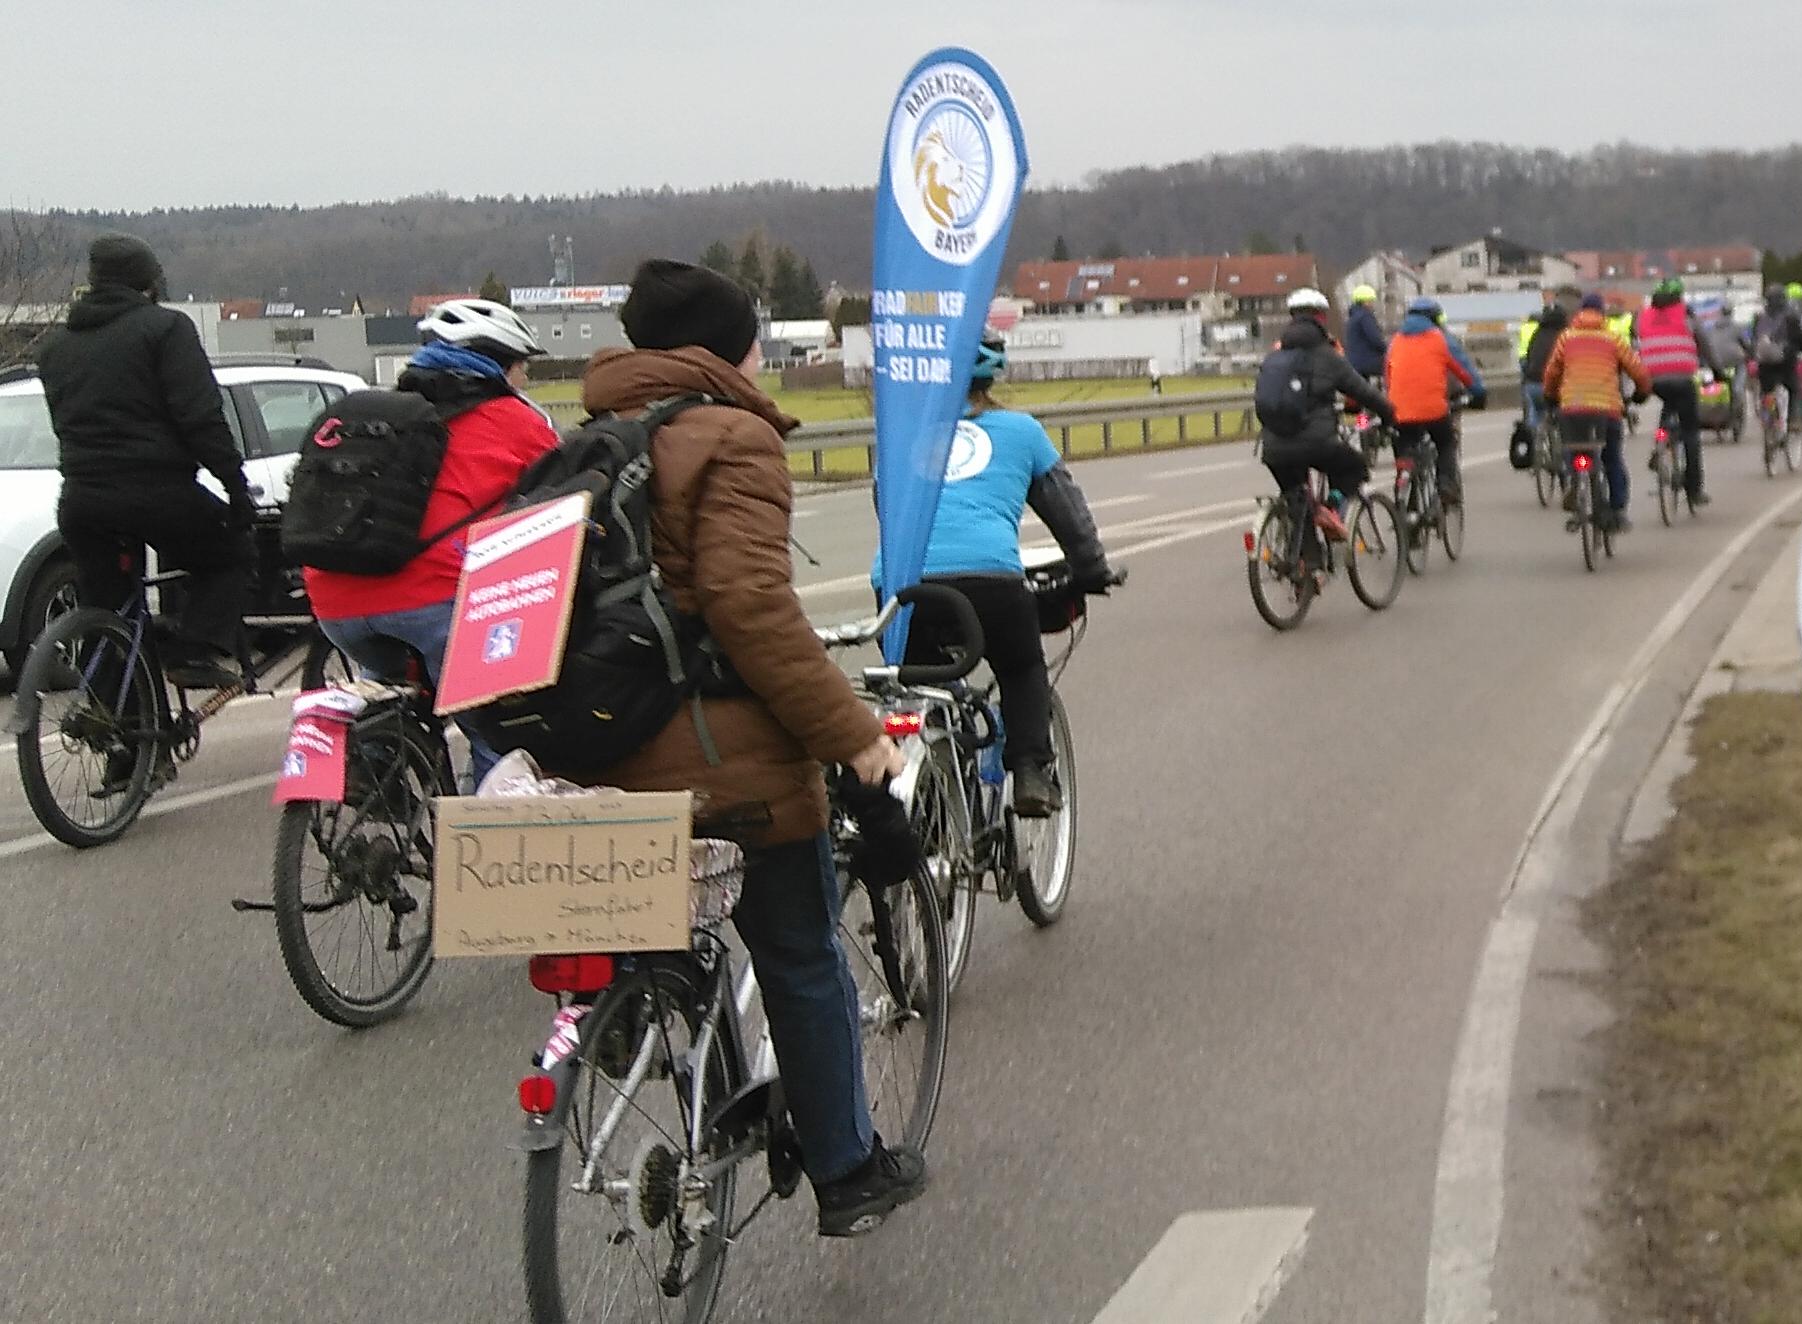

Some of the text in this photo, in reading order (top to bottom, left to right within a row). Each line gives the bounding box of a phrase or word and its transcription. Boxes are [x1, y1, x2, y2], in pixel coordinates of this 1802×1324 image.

[905, 73, 995, 121] RADENTSCHEID
[874, 317, 945, 349] FÜR ALLE
[889, 356, 913, 382] SEI
[454, 832, 679, 893] Radentscheid
